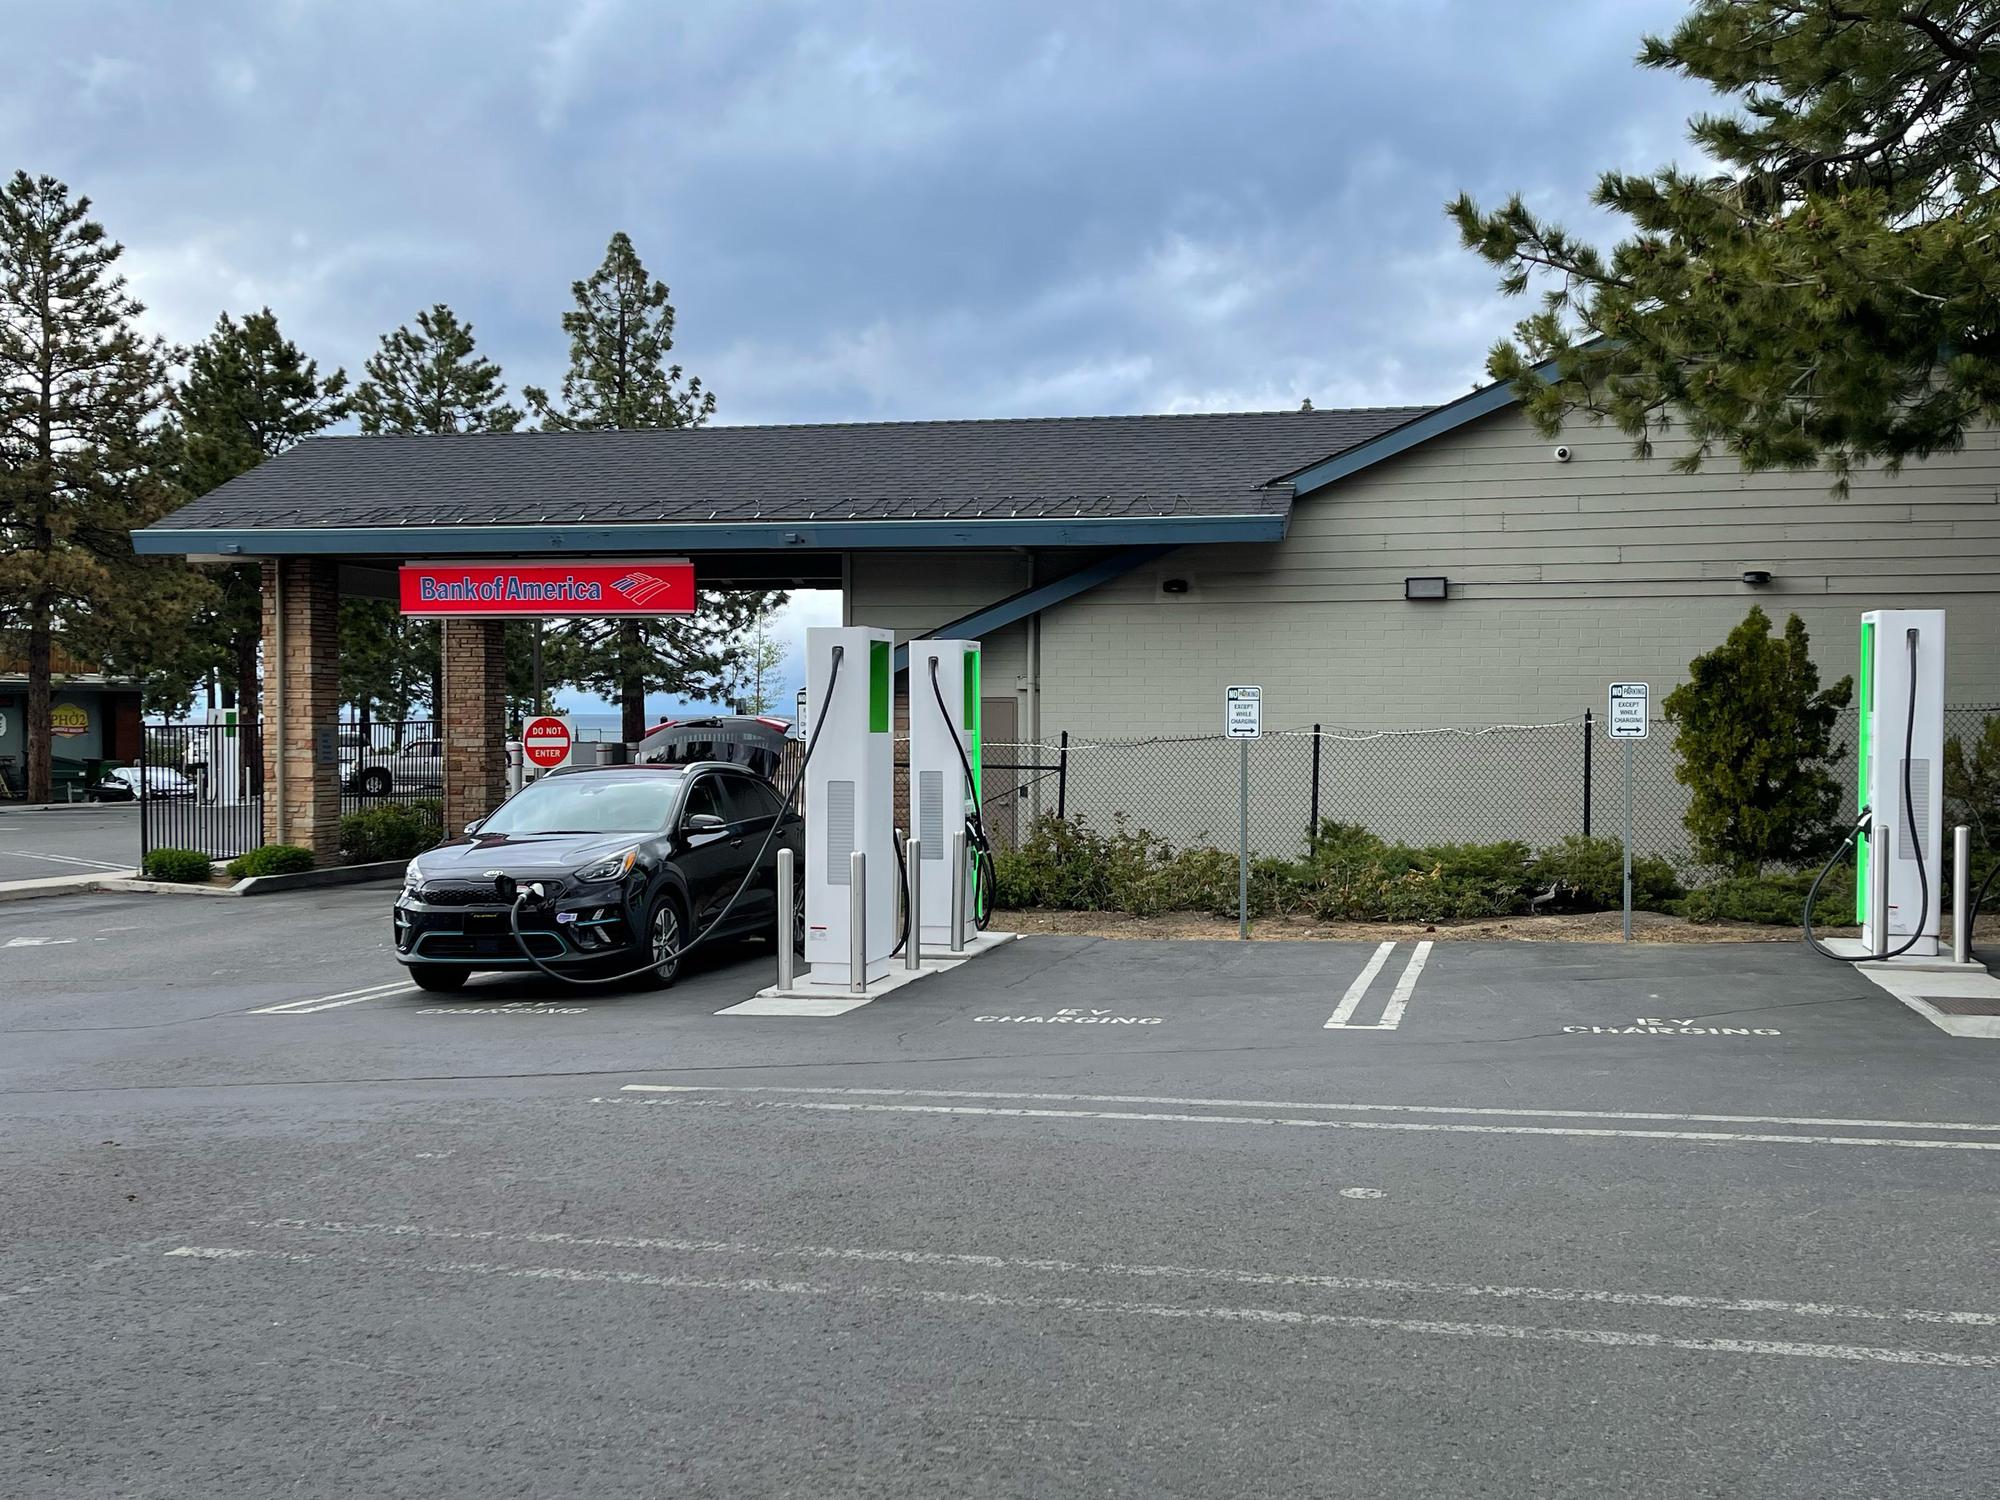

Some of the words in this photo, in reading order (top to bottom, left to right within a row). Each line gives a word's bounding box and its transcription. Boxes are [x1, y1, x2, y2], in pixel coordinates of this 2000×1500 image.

[420, 576, 478, 600] Bank
[479, 576, 504, 600] of
[505, 576, 602, 600] America
[1229, 690, 1238, 698] NO
[1612, 687, 1622, 696] NO
[532, 726, 544, 735] DO
[545, 726, 562, 735] NOT
[535, 749, 561, 758] ENTER
[973, 1016, 1167, 1024] CHARGING
[1636, 1018, 1695, 1026] EV
[1563, 1026, 1782, 1036] CHARGING
